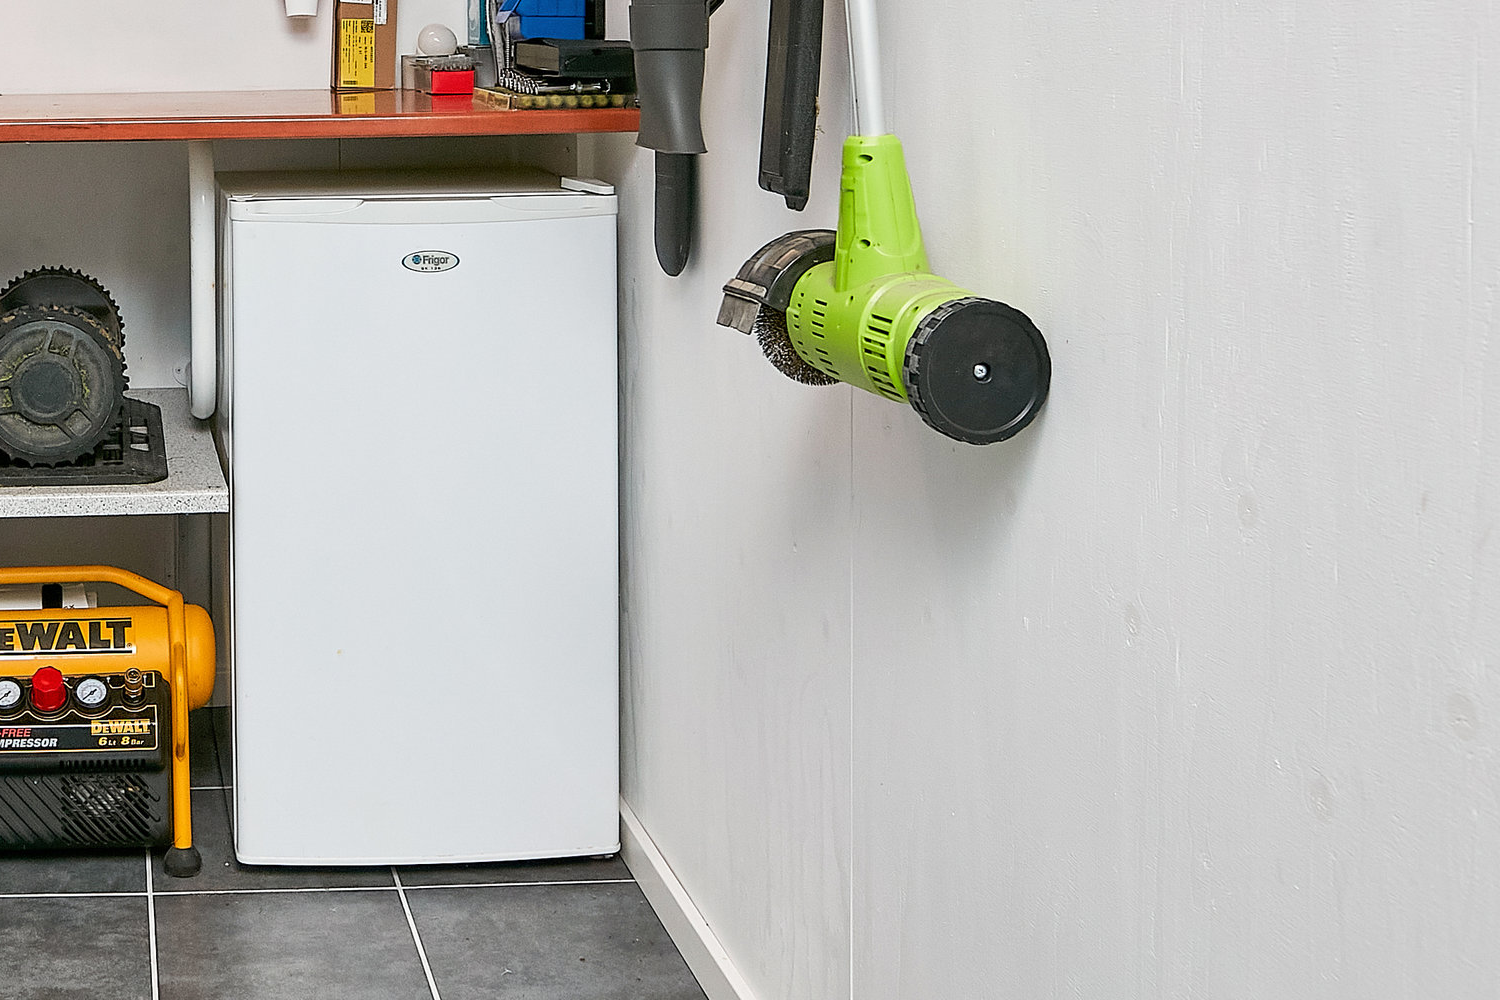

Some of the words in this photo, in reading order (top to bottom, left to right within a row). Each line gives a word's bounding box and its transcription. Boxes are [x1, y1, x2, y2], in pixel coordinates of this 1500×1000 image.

[422, 254, 450, 266] Frigor
[98, 736, 108, 746] 6
[120, 736, 131, 746] 8
